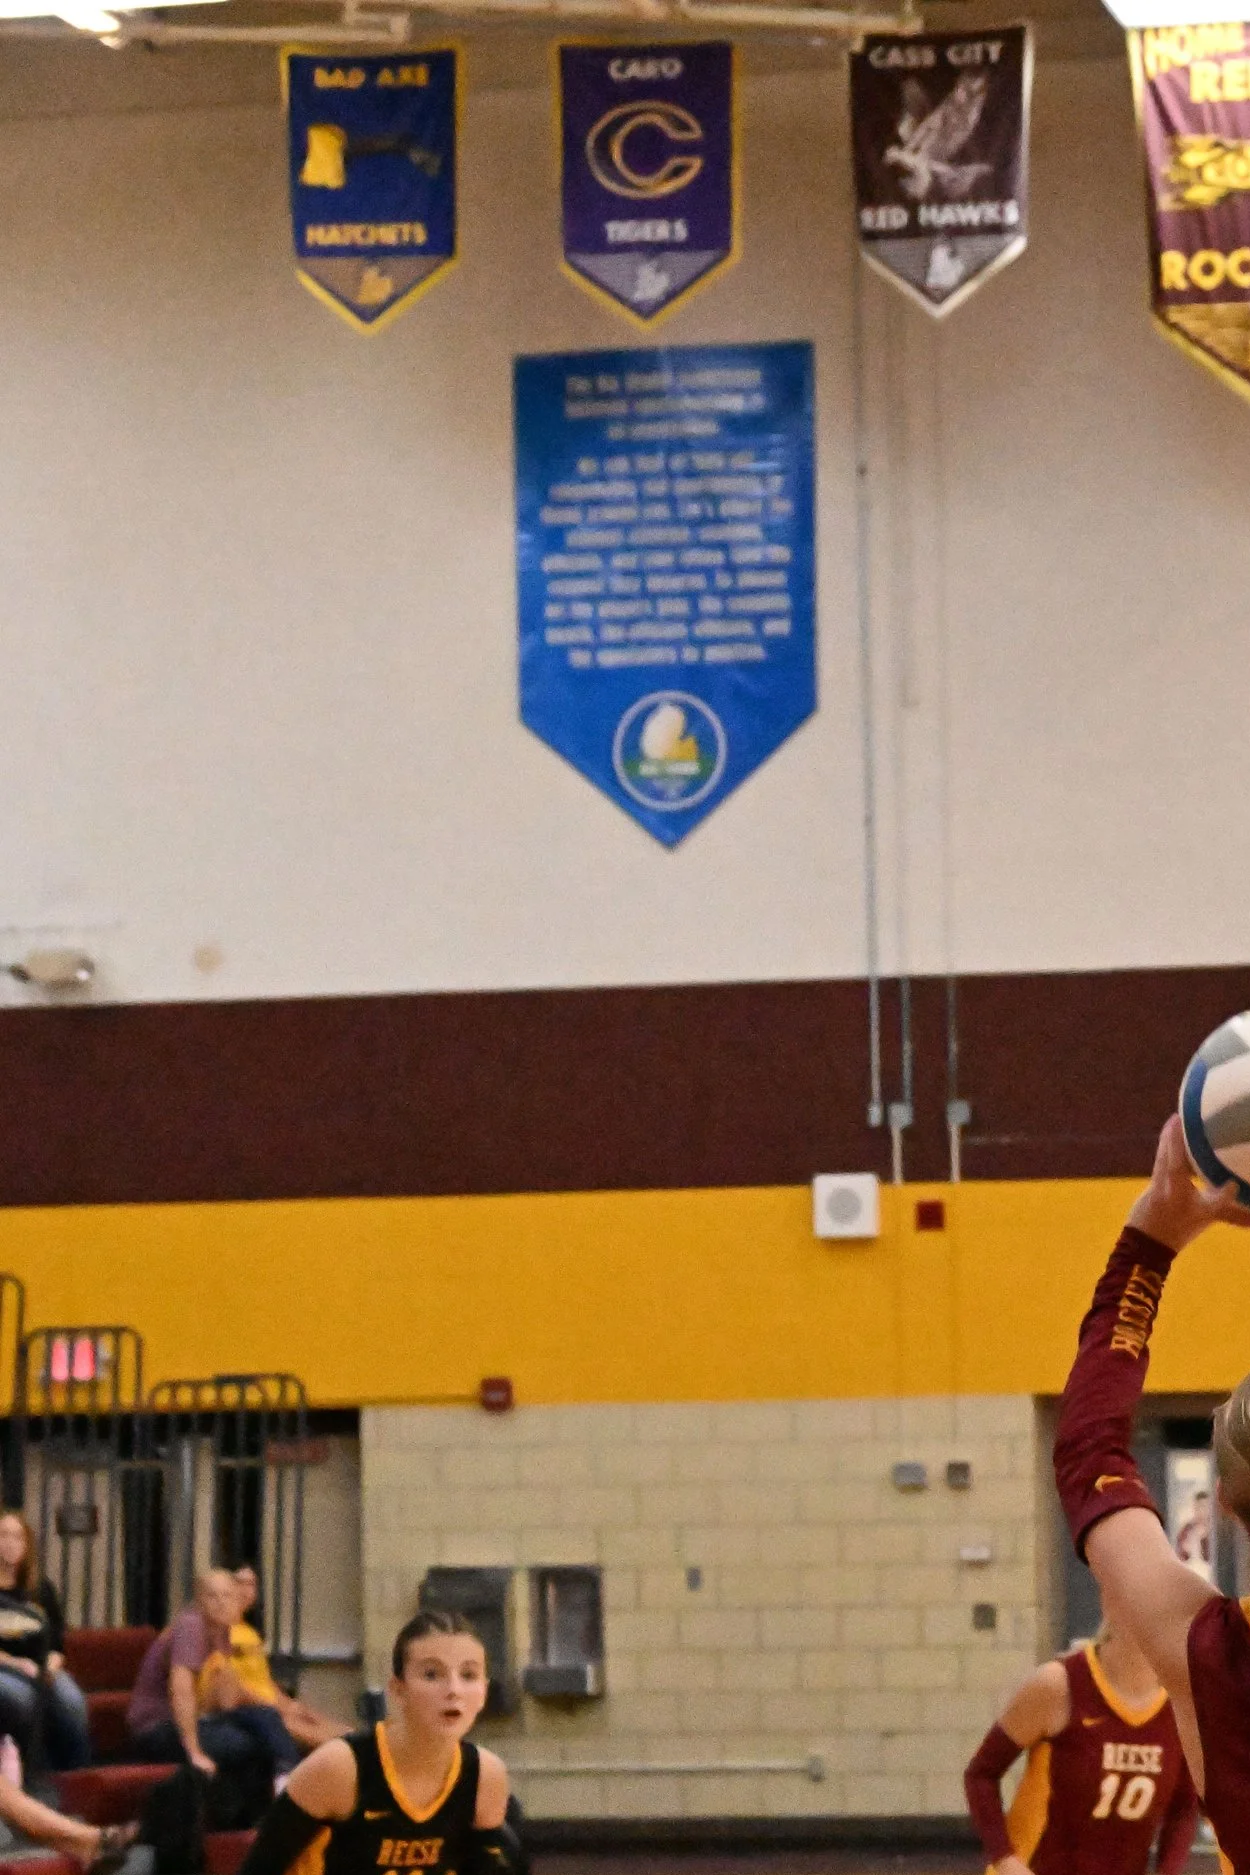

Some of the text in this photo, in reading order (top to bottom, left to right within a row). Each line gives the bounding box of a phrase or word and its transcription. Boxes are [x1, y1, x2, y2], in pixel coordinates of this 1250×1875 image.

[860, 199, 1020, 231] RED HAWKS
[1103, 1742, 1163, 1774] REESE
[1092, 1773, 1155, 1821] 10
[376, 1837, 445, 1866] REESE
